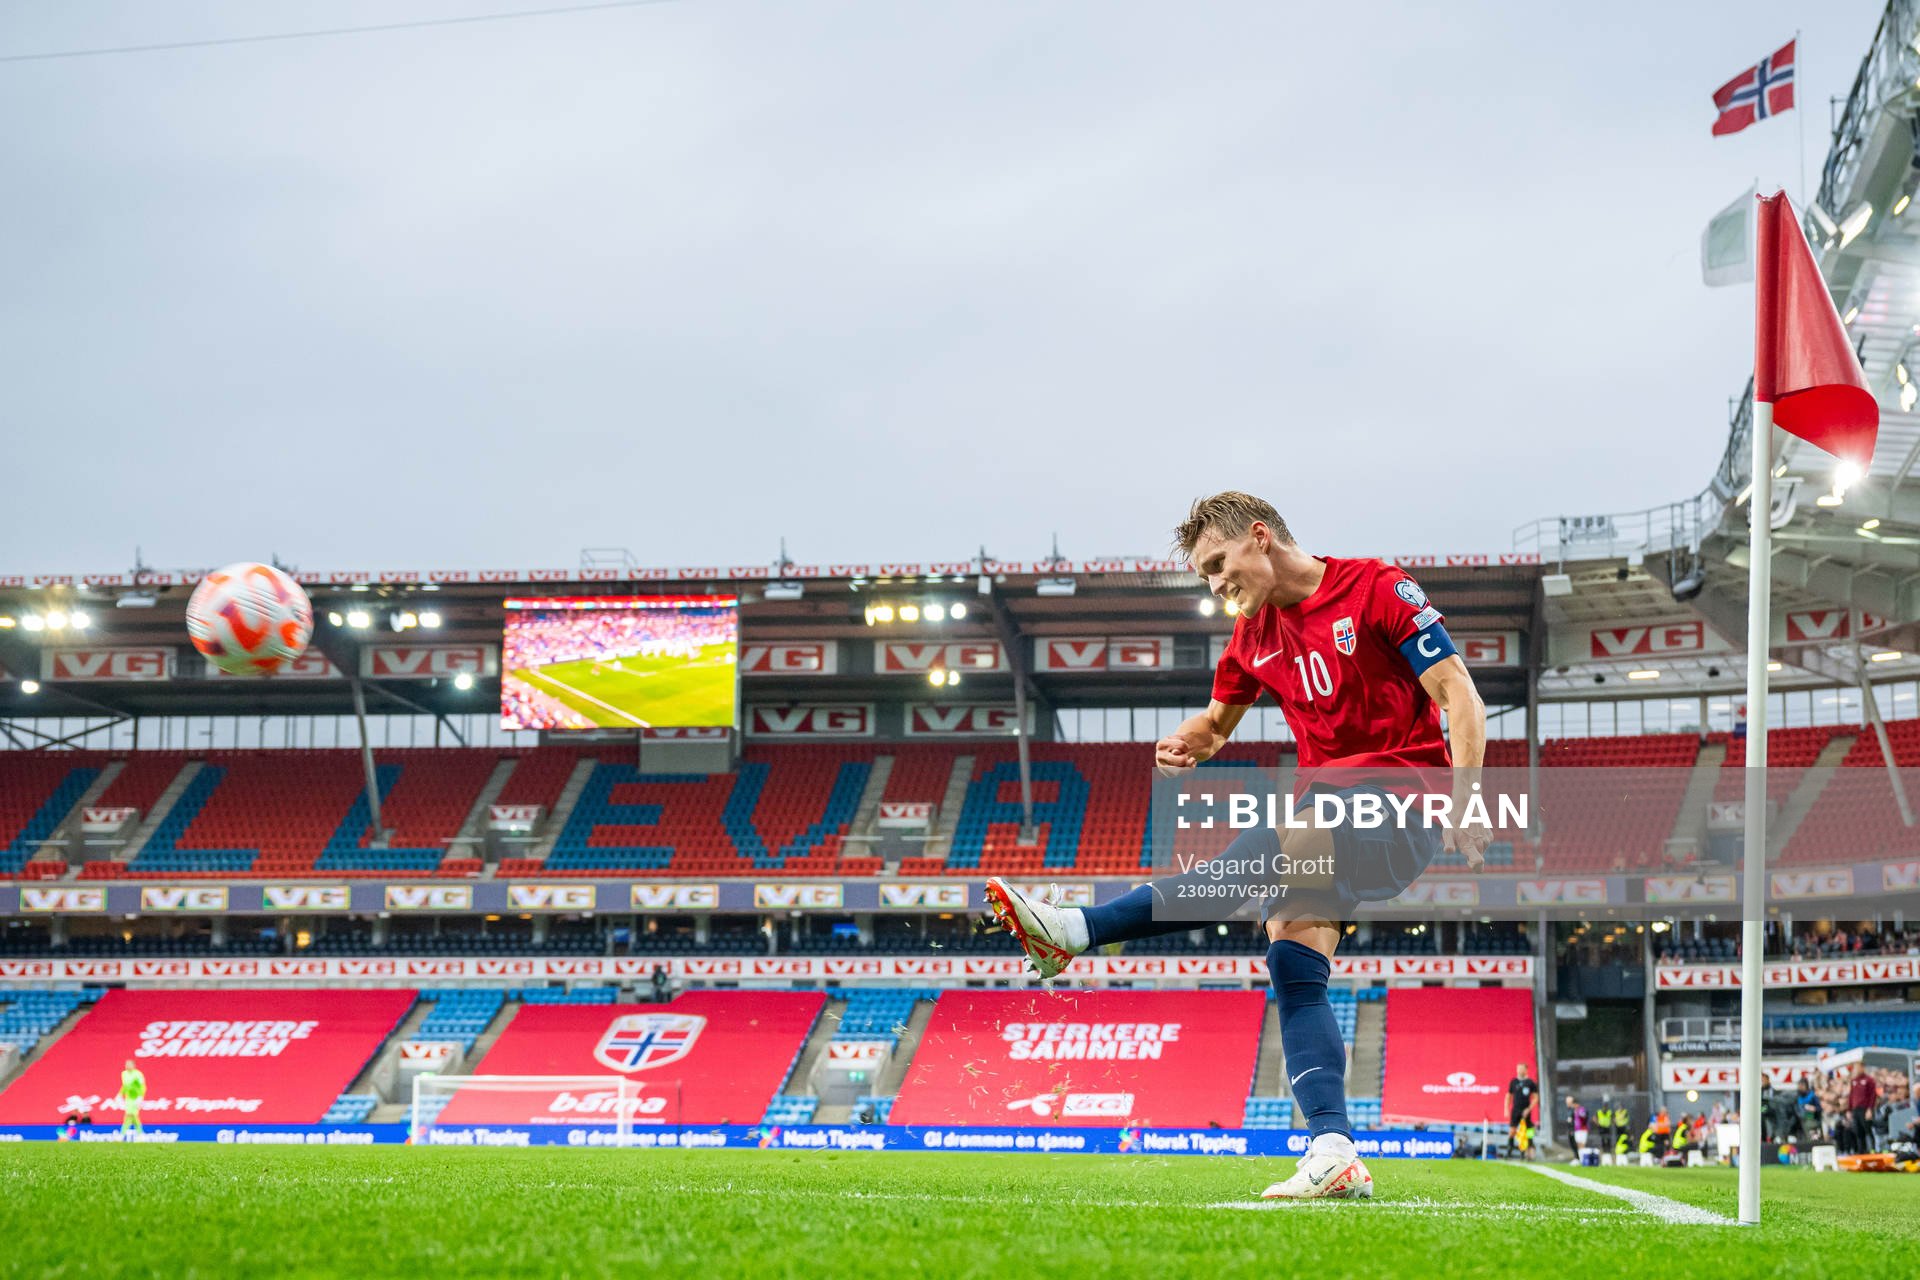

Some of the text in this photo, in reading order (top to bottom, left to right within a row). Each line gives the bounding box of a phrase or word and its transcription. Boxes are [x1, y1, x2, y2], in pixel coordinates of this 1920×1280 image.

[1417, 634, 1441, 658] C
[1593, 622, 1702, 656] VG
[56, 650, 163, 678] VG
[375, 647, 484, 677] VG
[888, 641, 996, 669] VG
[1050, 639, 1158, 668] VG
[1295, 651, 1333, 701] 10
[756, 708, 864, 733] VG
[915, 707, 1024, 732] VG
[23, 889, 105, 910] VG
[144, 888, 227, 909] VG
[265, 888, 348, 909] VG
[387, 887, 471, 908] VG
[509, 887, 594, 908] VG
[633, 886, 717, 907] VG
[757, 885, 841, 906] VG
[881, 885, 966, 906] VG
[1519, 881, 1604, 902] VG
[1648, 878, 1733, 901] VG
[1773, 873, 1850, 896] VG
[66, 962, 120, 976] VG
[134, 962, 188, 976] VG
[203, 962, 257, 976] VG
[271, 962, 325, 976] VG
[340, 962, 394, 976] VG
[408, 962, 463, 976] VG
[477, 962, 532, 976] VG
[546, 961, 601, 975] VG
[615, 961, 669, 975] VG
[685, 961, 740, 975] VG
[755, 961, 810, 975] VG
[825, 961, 880, 975] VG
[895, 961, 950, 975] VG
[966, 960, 1021, 974] VG
[1107, 960, 1162, 974] VG
[1178, 960, 1235, 974] VG
[1395, 960, 1452, 973] VG
[1468, 959, 1526, 973] VG
[1660, 969, 1722, 985] VG
[1800, 964, 1856, 982] VG
[1864, 961, 1912, 978] VG
[139, 1021, 320, 1039] STERKERE
[1002, 1022, 1182, 1042] STERKERE
[135, 1039, 290, 1057] SAMMEN
[830, 1043, 886, 1059] VG
[1008, 1041, 1164, 1060] SAMMEN
[1674, 1067, 1738, 1084] VG
[175, 1097, 264, 1112] Tipping
[783, 1129, 885, 1149] Norsk Tipping
[924, 1131, 941, 1147] Gi
[1037, 1133, 1085, 1151] sjanse
[1143, 1133, 1248, 1154] Norsk Tipping
[1403, 1138, 1452, 1155] sjanse
